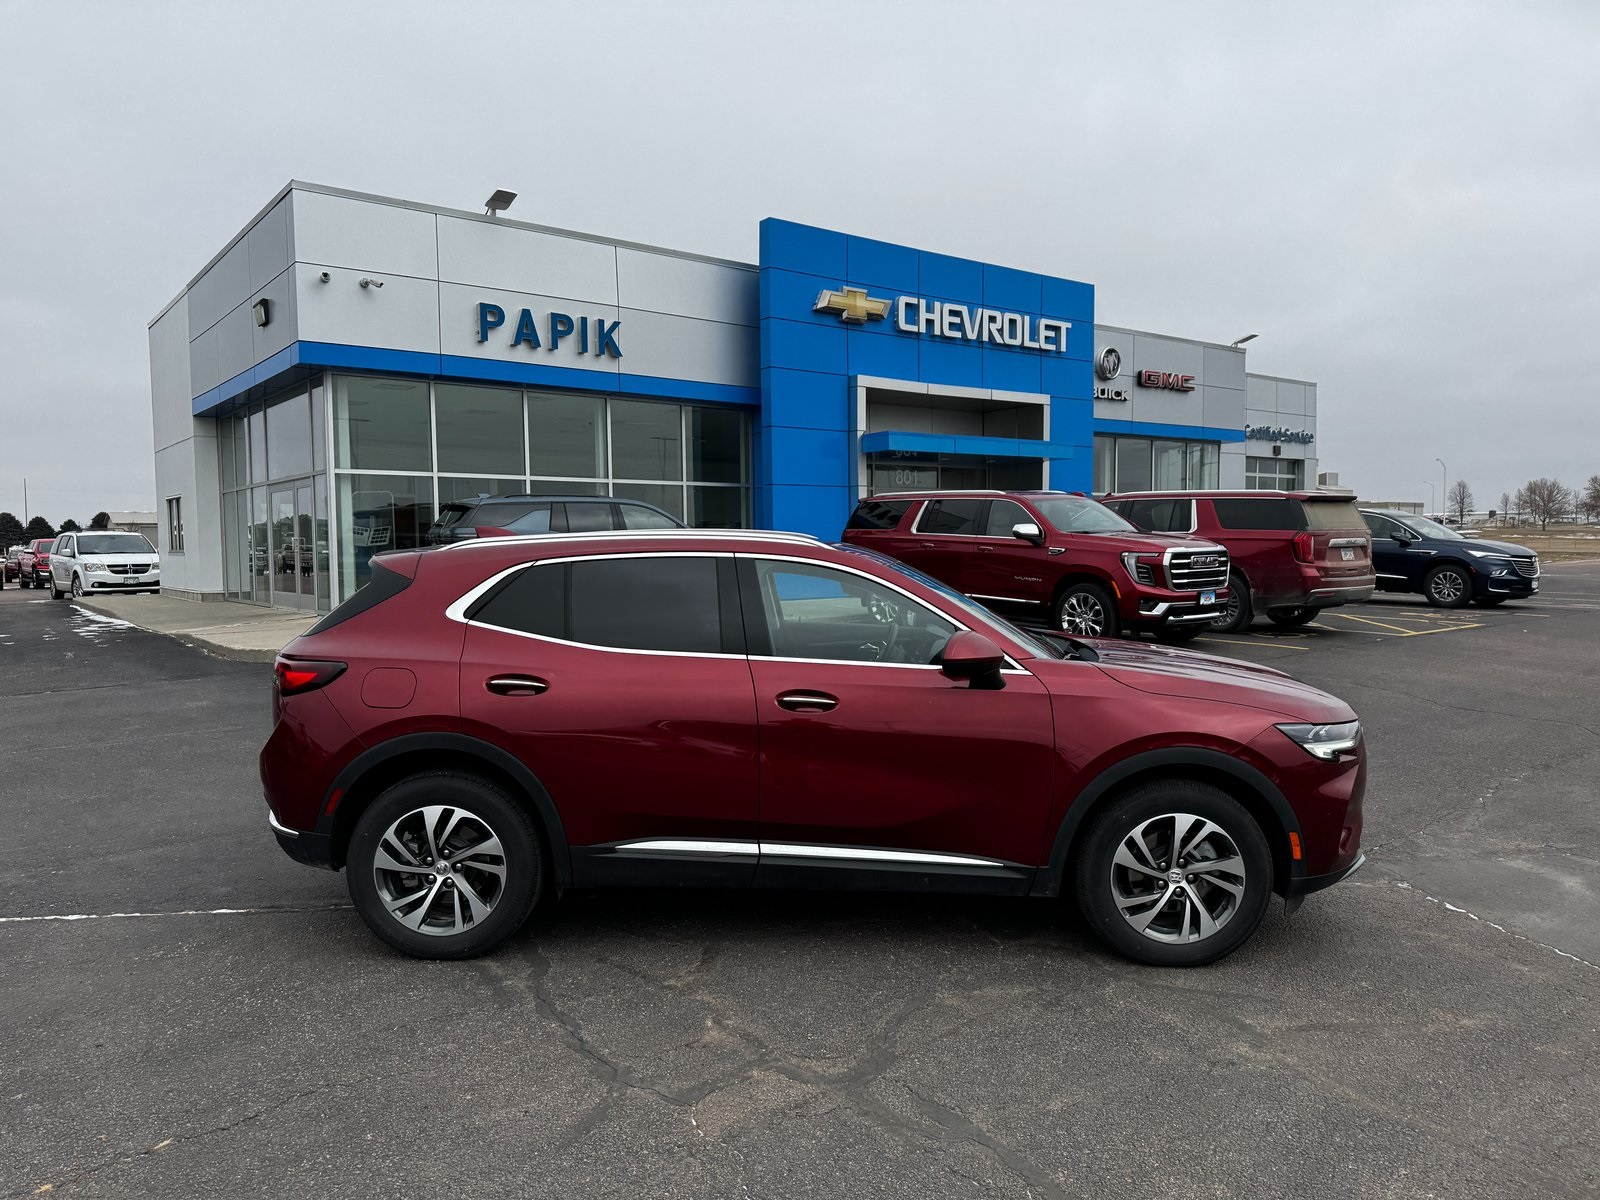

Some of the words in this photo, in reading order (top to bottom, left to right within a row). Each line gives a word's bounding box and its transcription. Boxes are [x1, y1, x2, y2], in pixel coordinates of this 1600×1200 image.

[476, 302, 623, 358] PAPIK
[895, 295, 1072, 352] CHEVROLET
[1138, 369, 1195, 392] GMC
[1282, 428, 1314, 444] Service
[895, 469, 918, 485] 801
